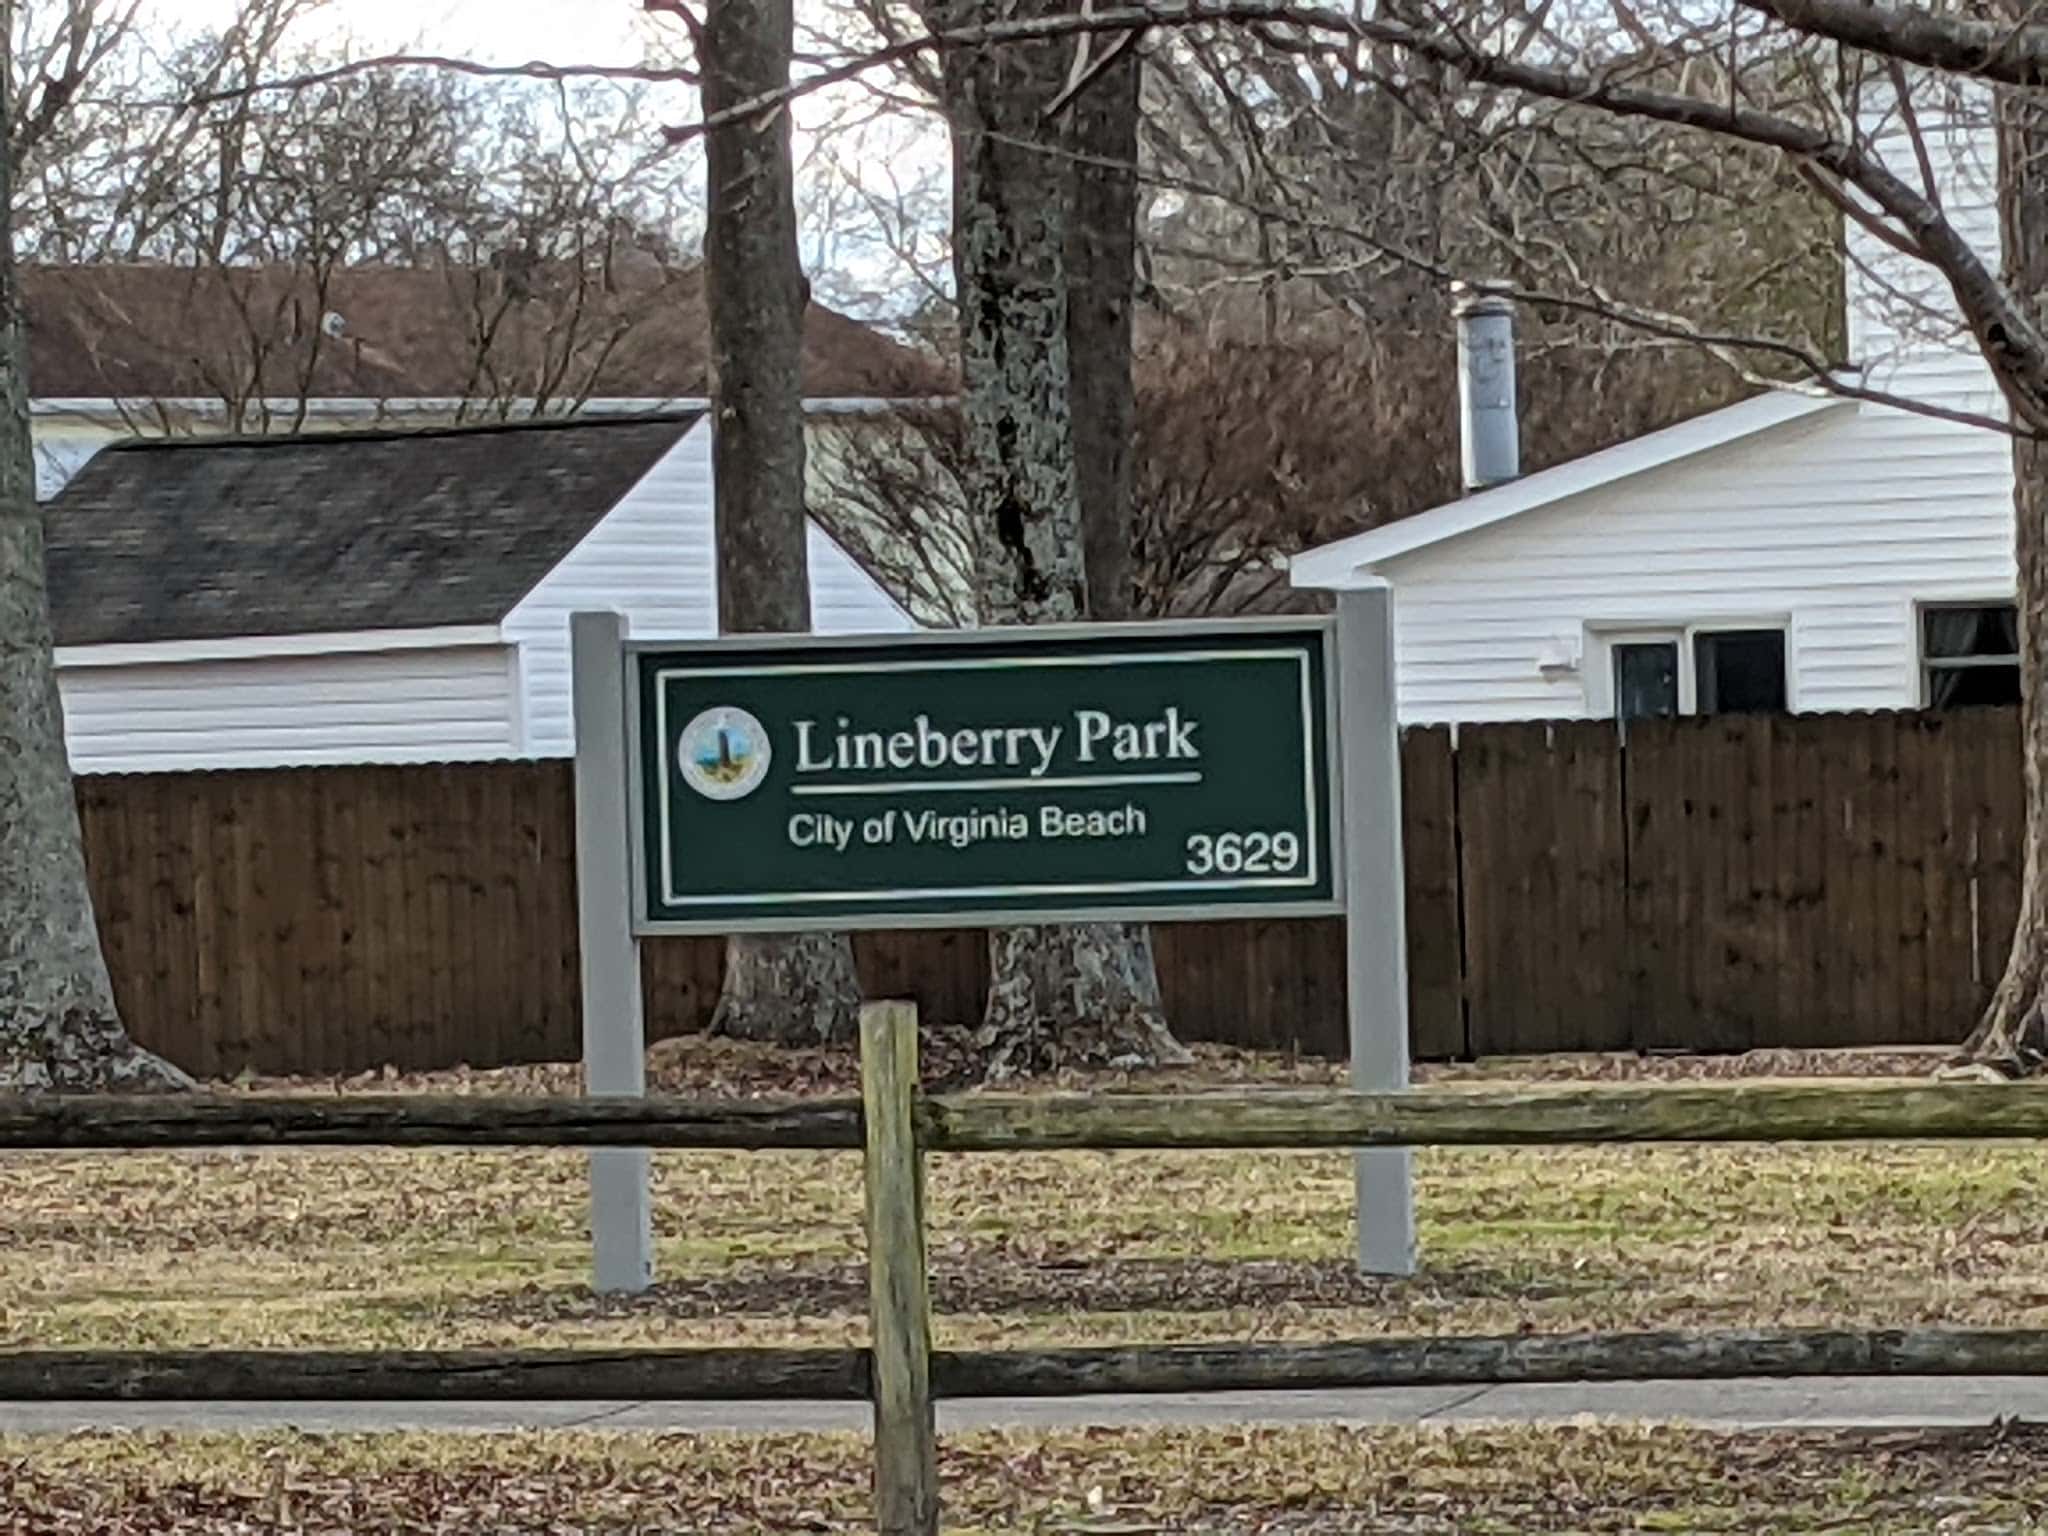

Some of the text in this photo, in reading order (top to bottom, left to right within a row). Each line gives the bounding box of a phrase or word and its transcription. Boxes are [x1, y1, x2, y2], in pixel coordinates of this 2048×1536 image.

[793, 715, 1062, 777] Lineberry
[1075, 706, 1199, 762] Park
[788, 804, 1146, 851] City of Virginia Beach
[1186, 831, 1299, 875] 3629
